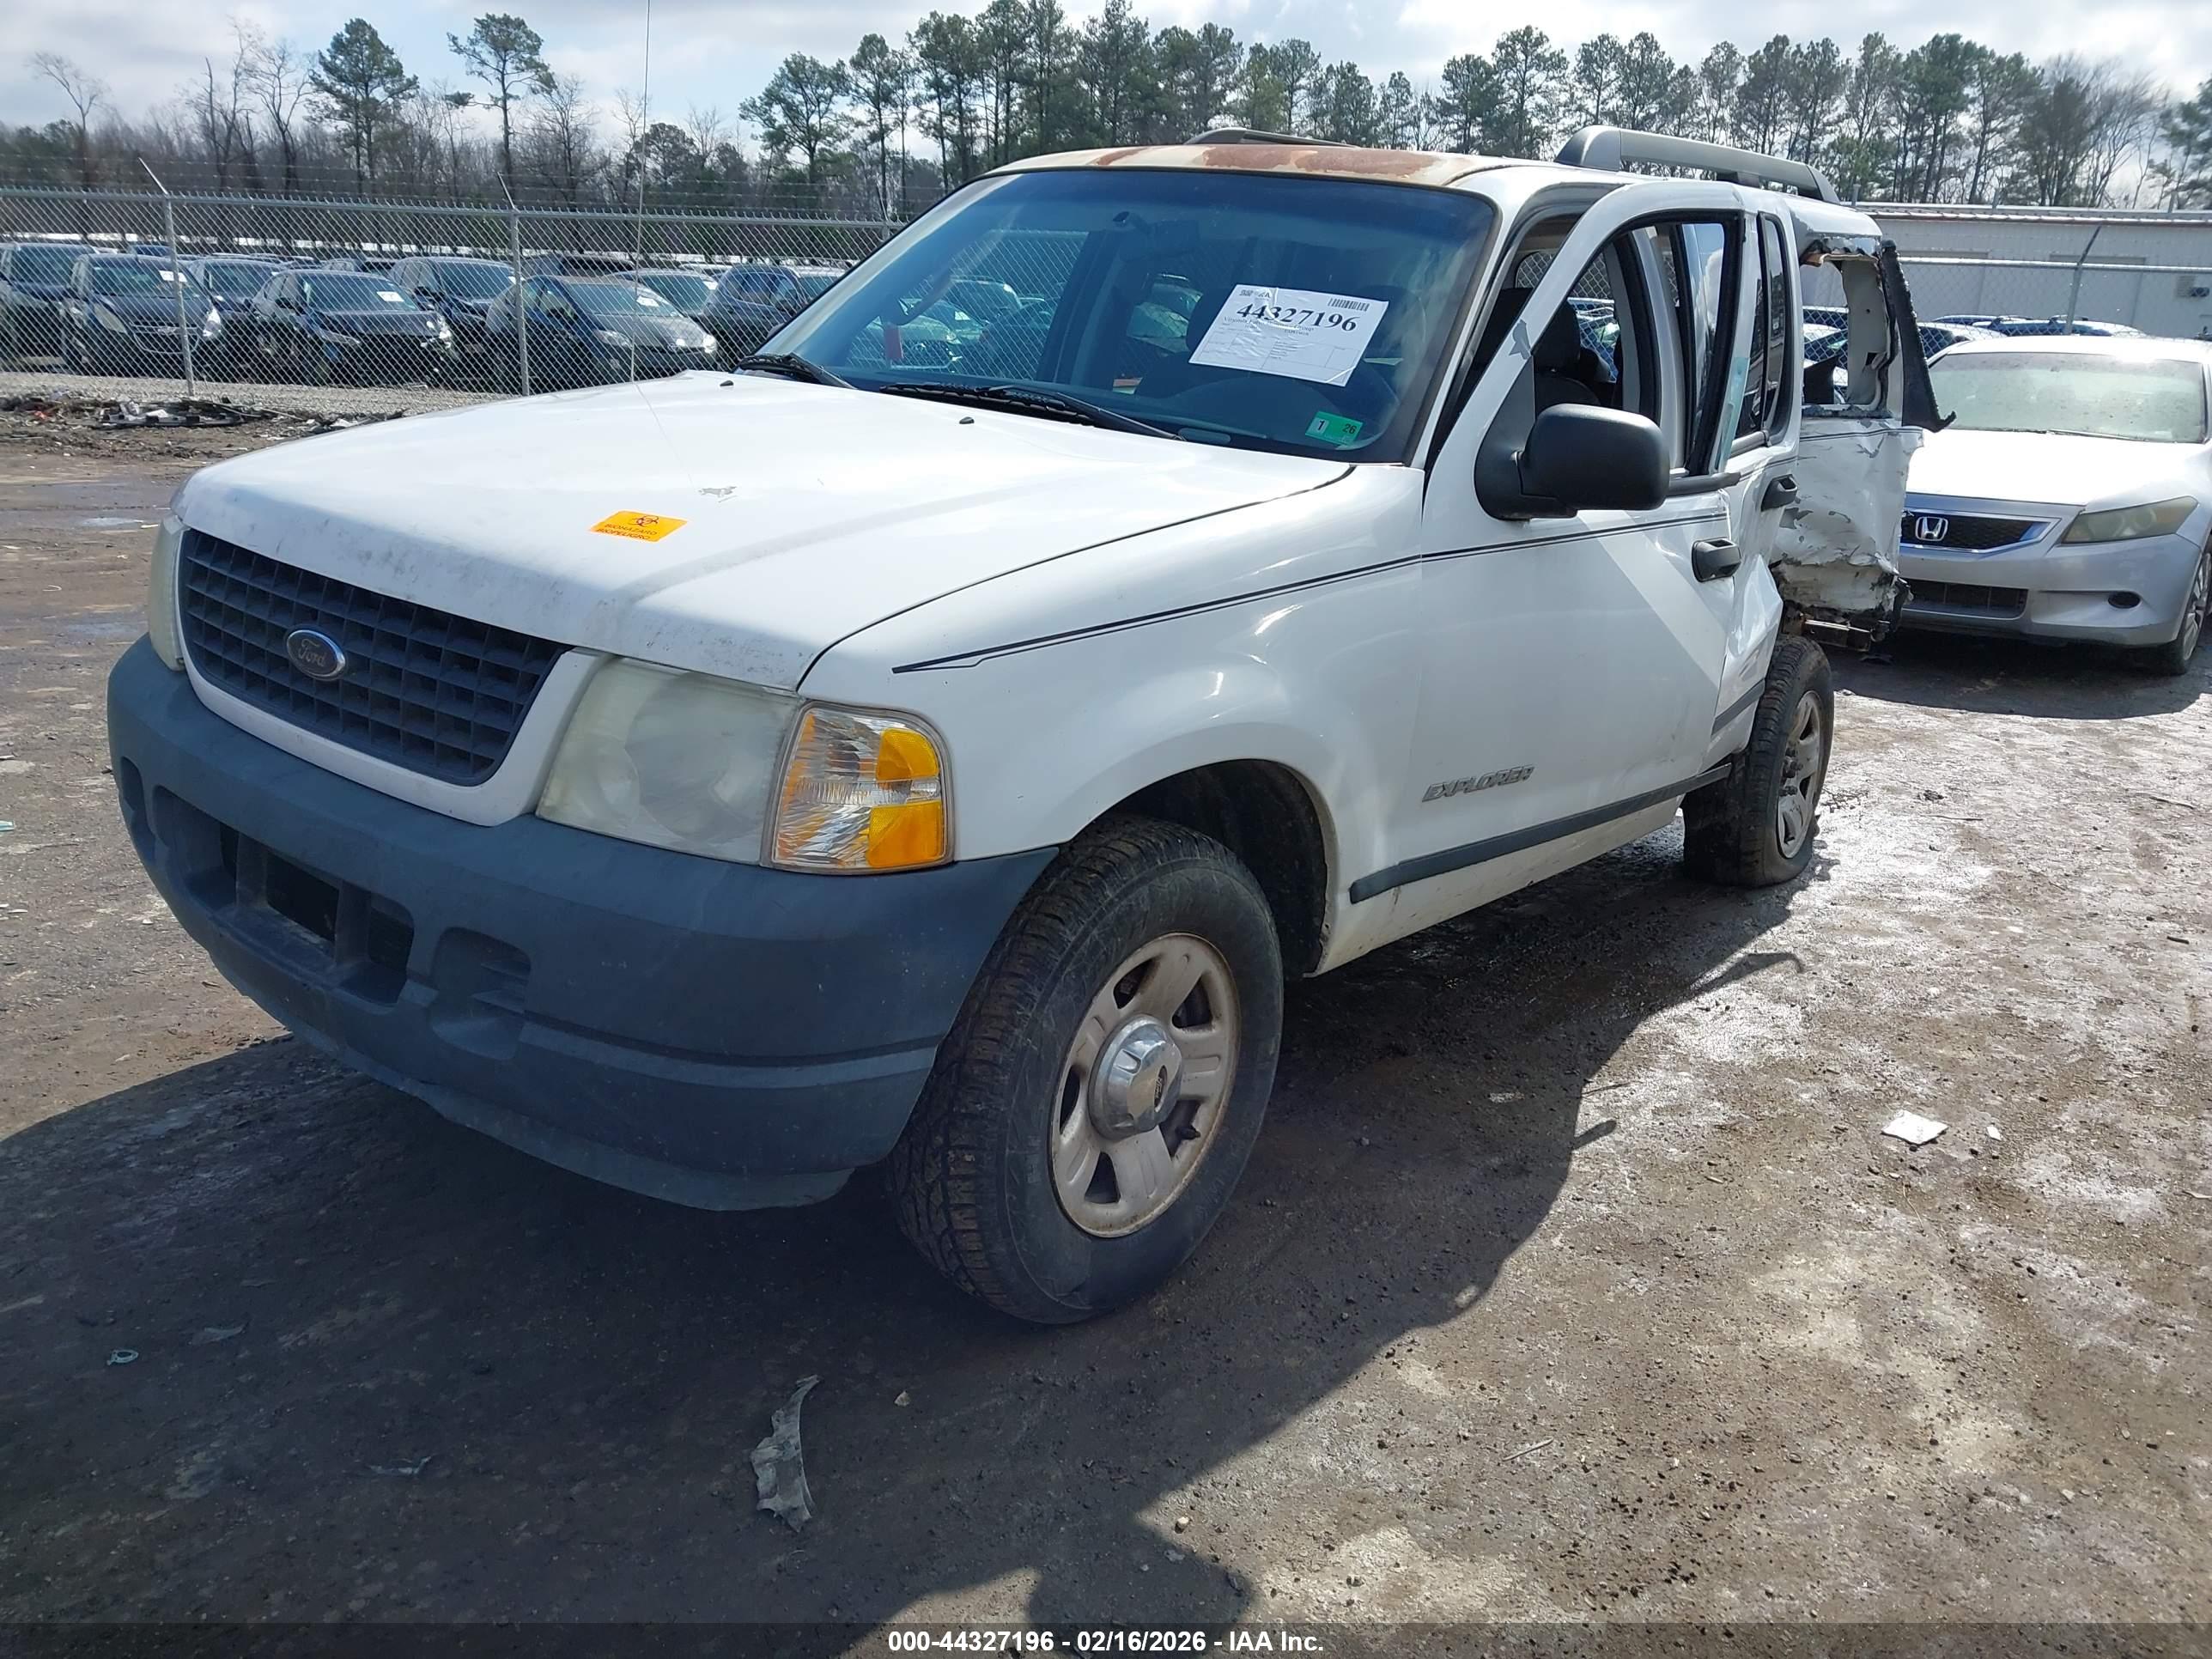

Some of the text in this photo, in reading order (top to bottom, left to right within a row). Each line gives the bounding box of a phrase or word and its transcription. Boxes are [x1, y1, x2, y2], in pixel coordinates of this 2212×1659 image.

[1237, 303, 1360, 331] 44327196
[1317, 419, 1358, 434] 1 26
[1421, 763, 1535, 802] EXPLORER
